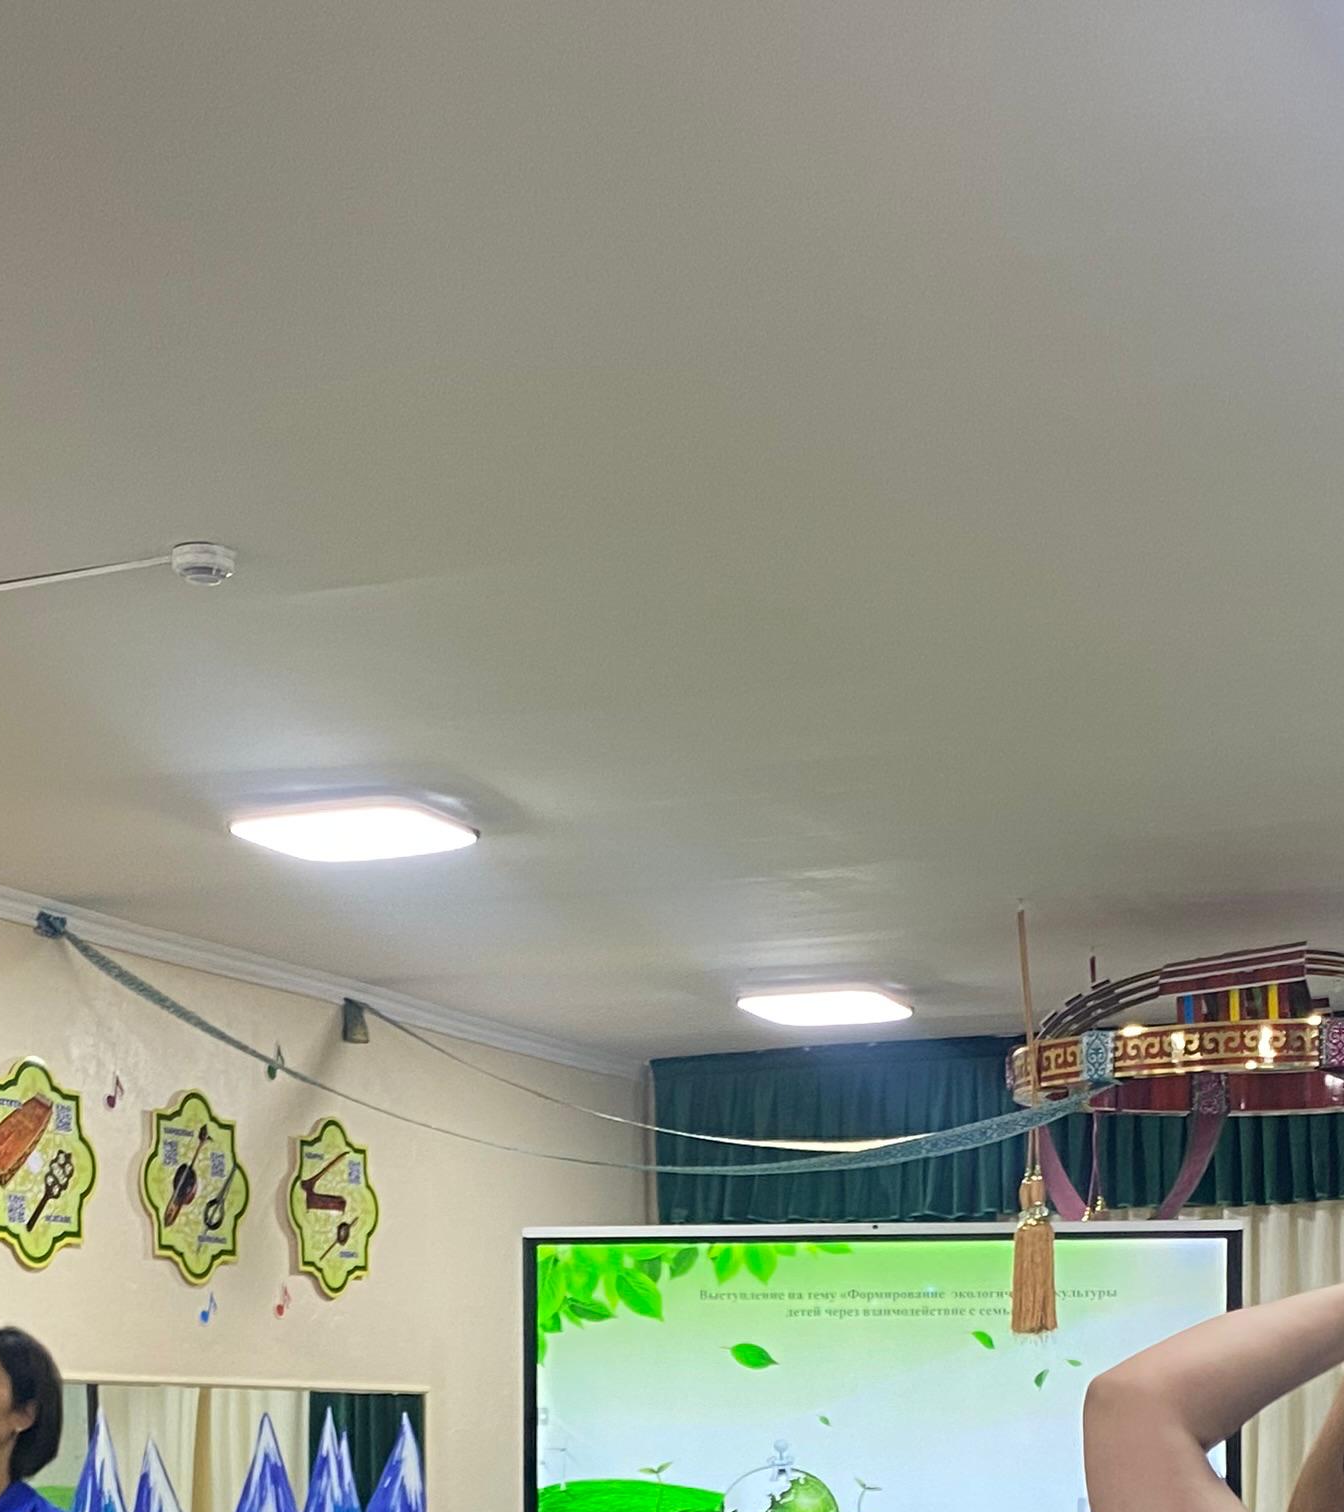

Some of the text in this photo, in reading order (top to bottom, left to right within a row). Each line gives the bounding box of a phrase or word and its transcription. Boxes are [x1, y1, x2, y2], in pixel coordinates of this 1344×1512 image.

[699, 1288, 785, 1304] Выступление
[787, 1291, 804, 1300] на
[807, 1291, 837, 1303] тему
[953, 1290, 1013, 1301] экологич
[786, 1306, 821, 1318] детей
[824, 1308, 860, 1318] через
